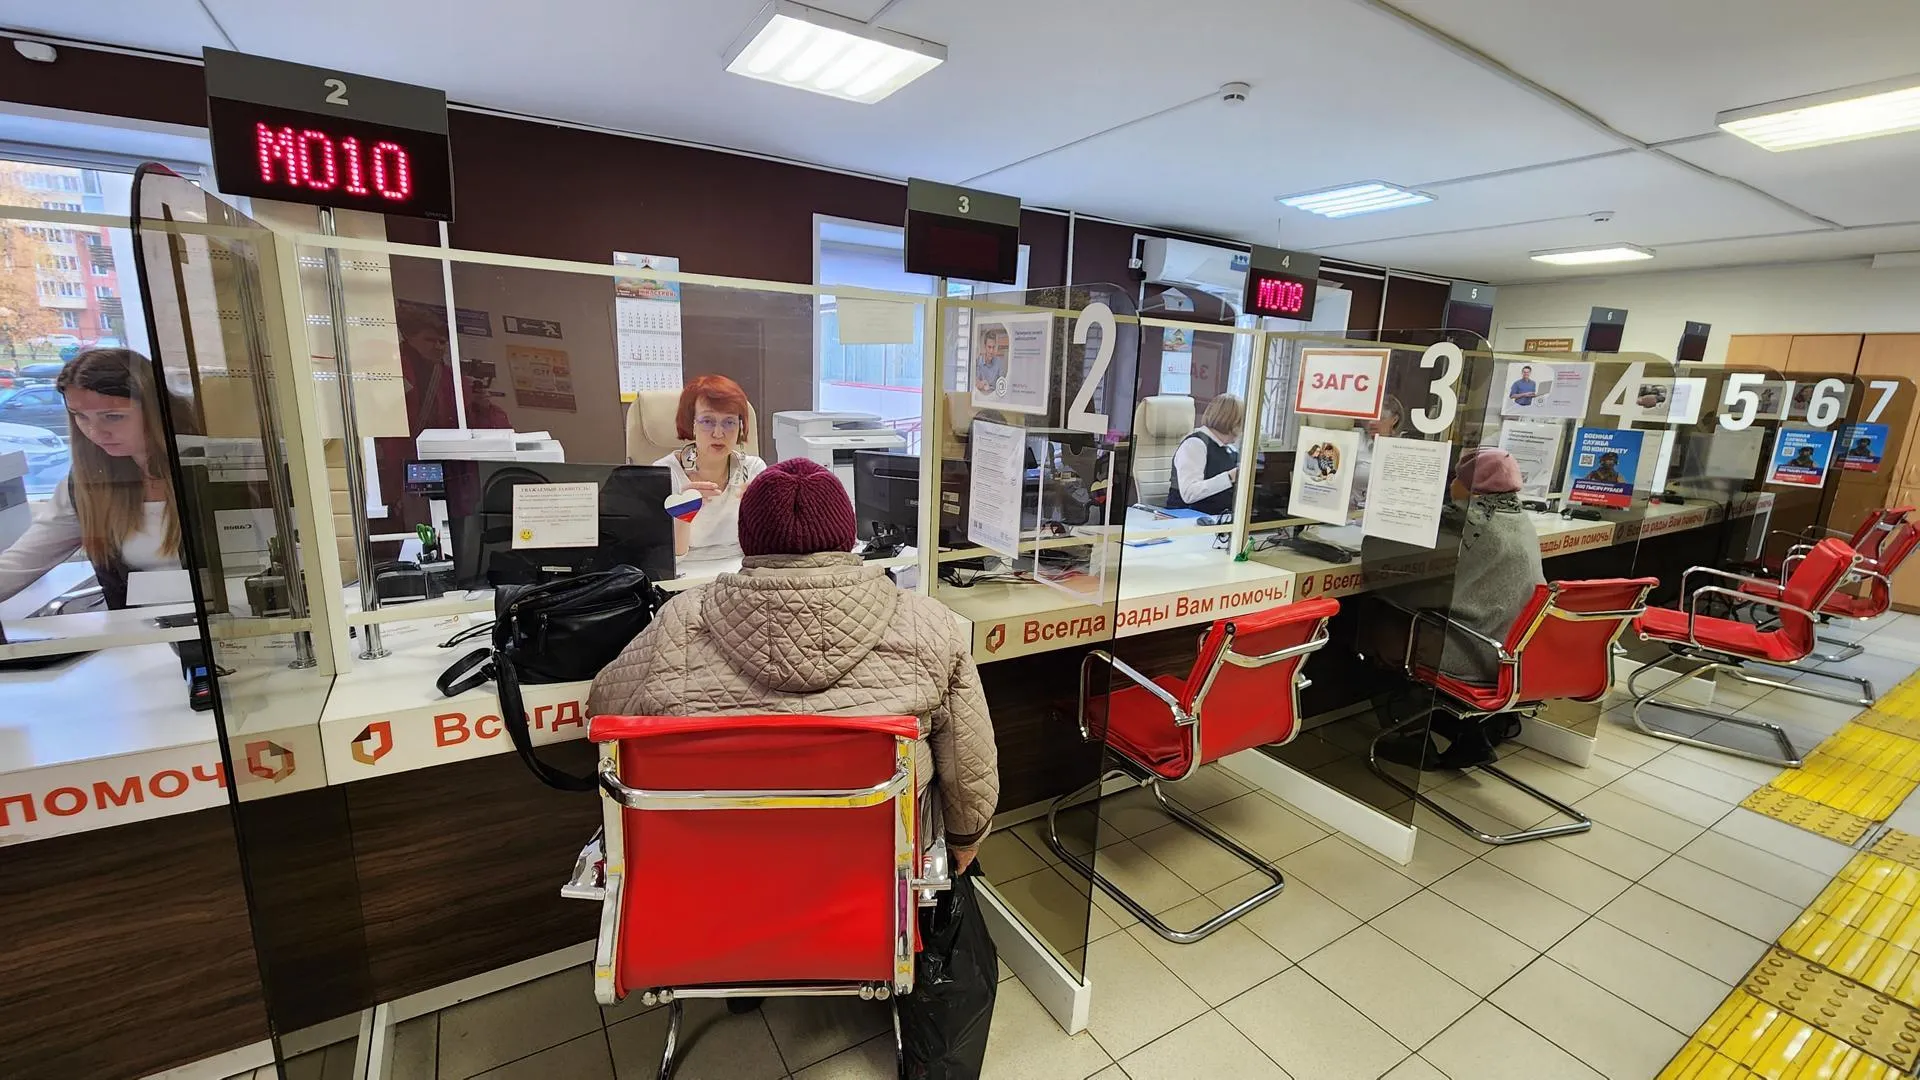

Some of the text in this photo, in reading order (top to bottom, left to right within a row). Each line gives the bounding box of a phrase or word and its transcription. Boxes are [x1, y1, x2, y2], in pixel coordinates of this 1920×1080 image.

[324, 78, 349, 105] 2
[958, 195, 970, 213] 3
[1281, 255, 1290, 268] 4
[1471, 288, 1478, 299] 5
[1607, 311, 1613, 320] 6
[1068, 302, 1116, 434] 2
[1311, 372, 1370, 392] ЗАГС
[1411, 341, 1463, 434] 3
[1600, 361, 1647, 430] 4
[1719, 373, 1765, 431] 5
[1806, 378, 1845, 427] 6
[1866, 381, 1899, 423] 7
[1582, 439, 1609, 447] СЛУЖБА
[1583, 432, 1614, 441] ВОЕННАЯ
[1591, 446, 1629, 455] КОНТРАКТУ
[1563, 535, 1580, 548] Вам
[1322, 572, 1367, 592] Всегд
[1024, 580, 1289, 644] Всегда рады Вам помочь!
[434, 700, 590, 748] Всгд
